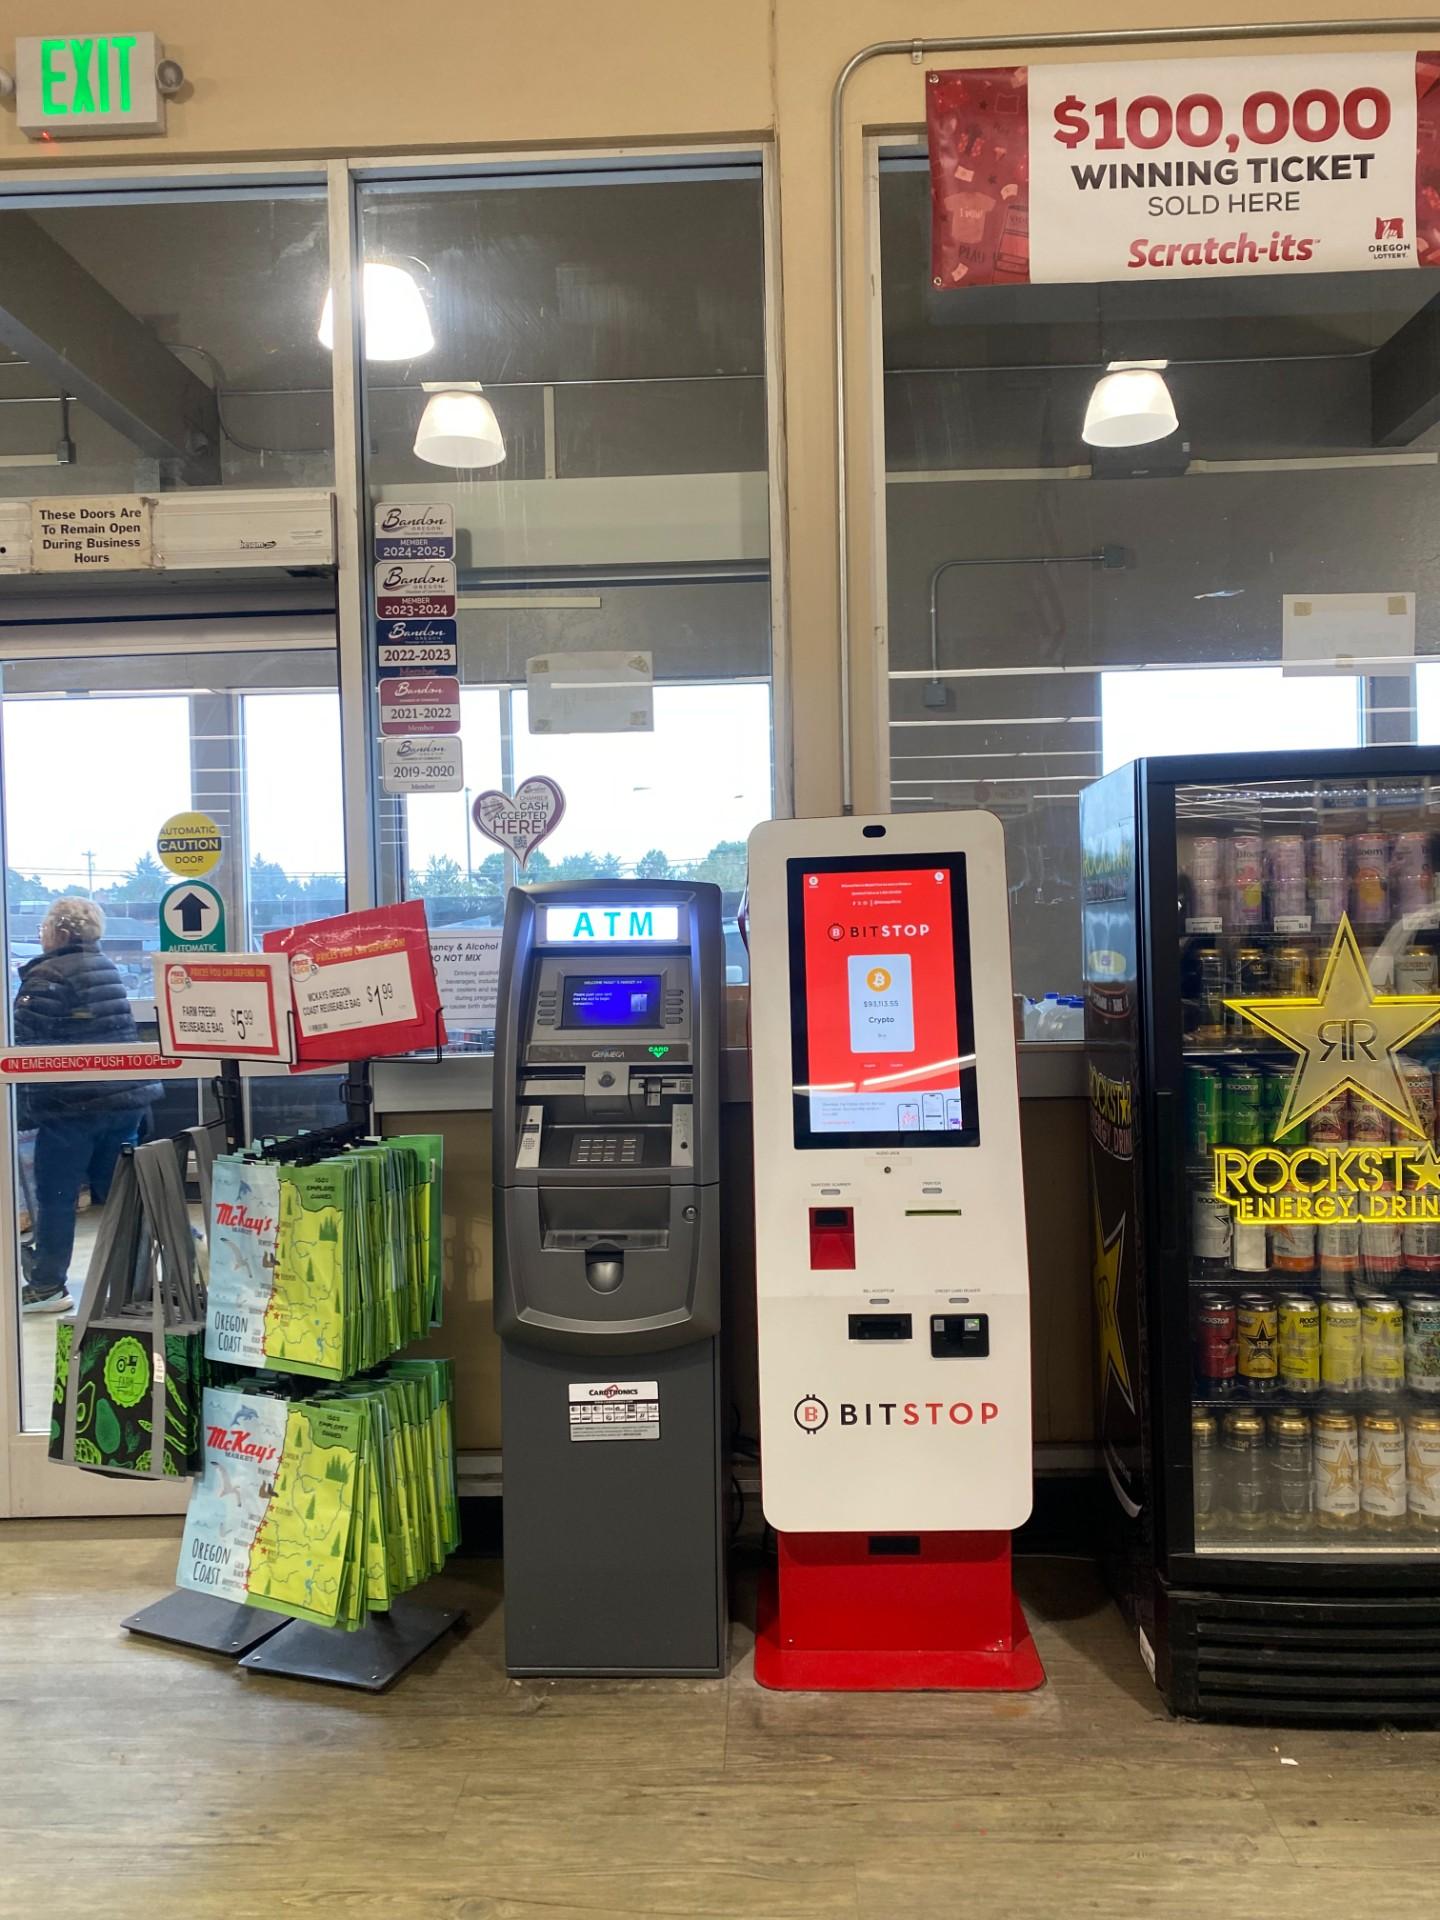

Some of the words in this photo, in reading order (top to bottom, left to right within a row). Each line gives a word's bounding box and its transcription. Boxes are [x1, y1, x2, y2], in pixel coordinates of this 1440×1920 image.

[40, 36, 136, 115] EXIT
[1053, 87, 1391, 153] $100,000
[1071, 158, 1239, 190] WINNING
[1247, 153, 1376, 184] TICKET
[1148, 195, 1219, 217] SOLD
[1228, 191, 1301, 213] HERE
[1368, 244, 1411, 252] OREGON
[39, 509, 76, 520] These
[80, 508, 116, 519] Doors
[120, 508, 142, 518] Are
[382, 507, 447, 530] Bandon
[42, 524, 56, 535] To
[60, 523, 105, 534] Remain
[109, 523, 141, 535] Open
[43, 538, 82, 550] During
[87, 537, 140, 549] Business
[74, 552, 110, 563] Hours
[384, 547, 446, 557] 2024-2025
[383, 565, 448, 590] Bandon
[385, 605, 448, 616] 2023-2024
[388, 621, 447, 640] Bandon
[384, 649, 451, 661] 2022-2023
[395, 682, 443, 697] Bandon
[391, 708, 452, 719] 2021-2022
[397, 740, 446, 757] Bandon
[394, 765, 455, 777] 2019-2020
[520, 802, 549, 810] CASH
[495, 811, 547, 820] ACCEPTED
[161, 826, 216, 836] AUTOMATIC
[493, 820, 547, 834] HERE!
[160, 839, 219, 851] CAUTION
[175, 856, 204, 864] DOOR
[573, 911, 654, 937] ATM
[850, 924, 930, 938] BITSTOP
[168, 944, 217, 952] AUTOMATIC
[466, 943, 498, 951] Alcohol
[465, 954, 482, 962] MIX
[213, 1022, 224, 1033] BAG
[868, 1016, 895, 1025] Crypto
[8, 1059, 19, 1070] IN
[21, 1057, 92, 1070] EMERGENCY
[94, 1056, 124, 1067] PUSH
[126, 1055, 142, 1066] TO
[145, 1055, 176, 1066] OPEN
[1241, 1196, 1354, 1218] ENERGY
[215, 1203, 272, 1235] McKay's
[214, 1311, 248, 1333] OREGON
[218, 1332, 242, 1353] COAST
[840, 1402, 999, 1426] BITSTOP
[206, 1425, 276, 1463] McKay's
[192, 1538, 231, 1565] OREGON
[193, 1561, 221, 1585] COAST
